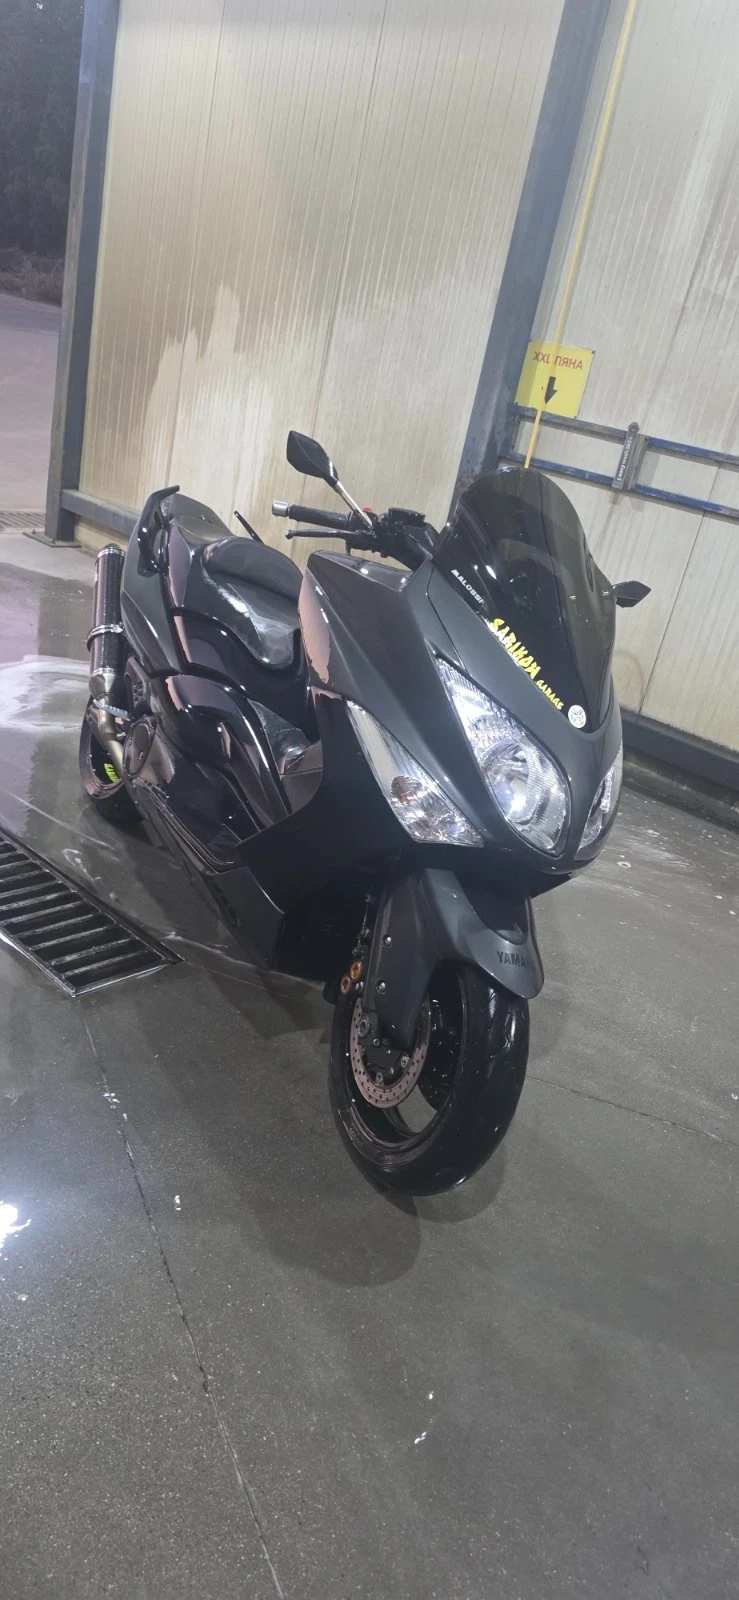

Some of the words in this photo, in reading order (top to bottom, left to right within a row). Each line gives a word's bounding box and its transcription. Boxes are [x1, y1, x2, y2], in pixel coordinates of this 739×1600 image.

[533, 351, 551, 364] XXL
[554, 355, 583, 370] ПЯНА
[450, 569, 484, 604] MALOSSI
[534, 679, 565, 710] GARAGE
[496, 950, 530, 968] YAMA
